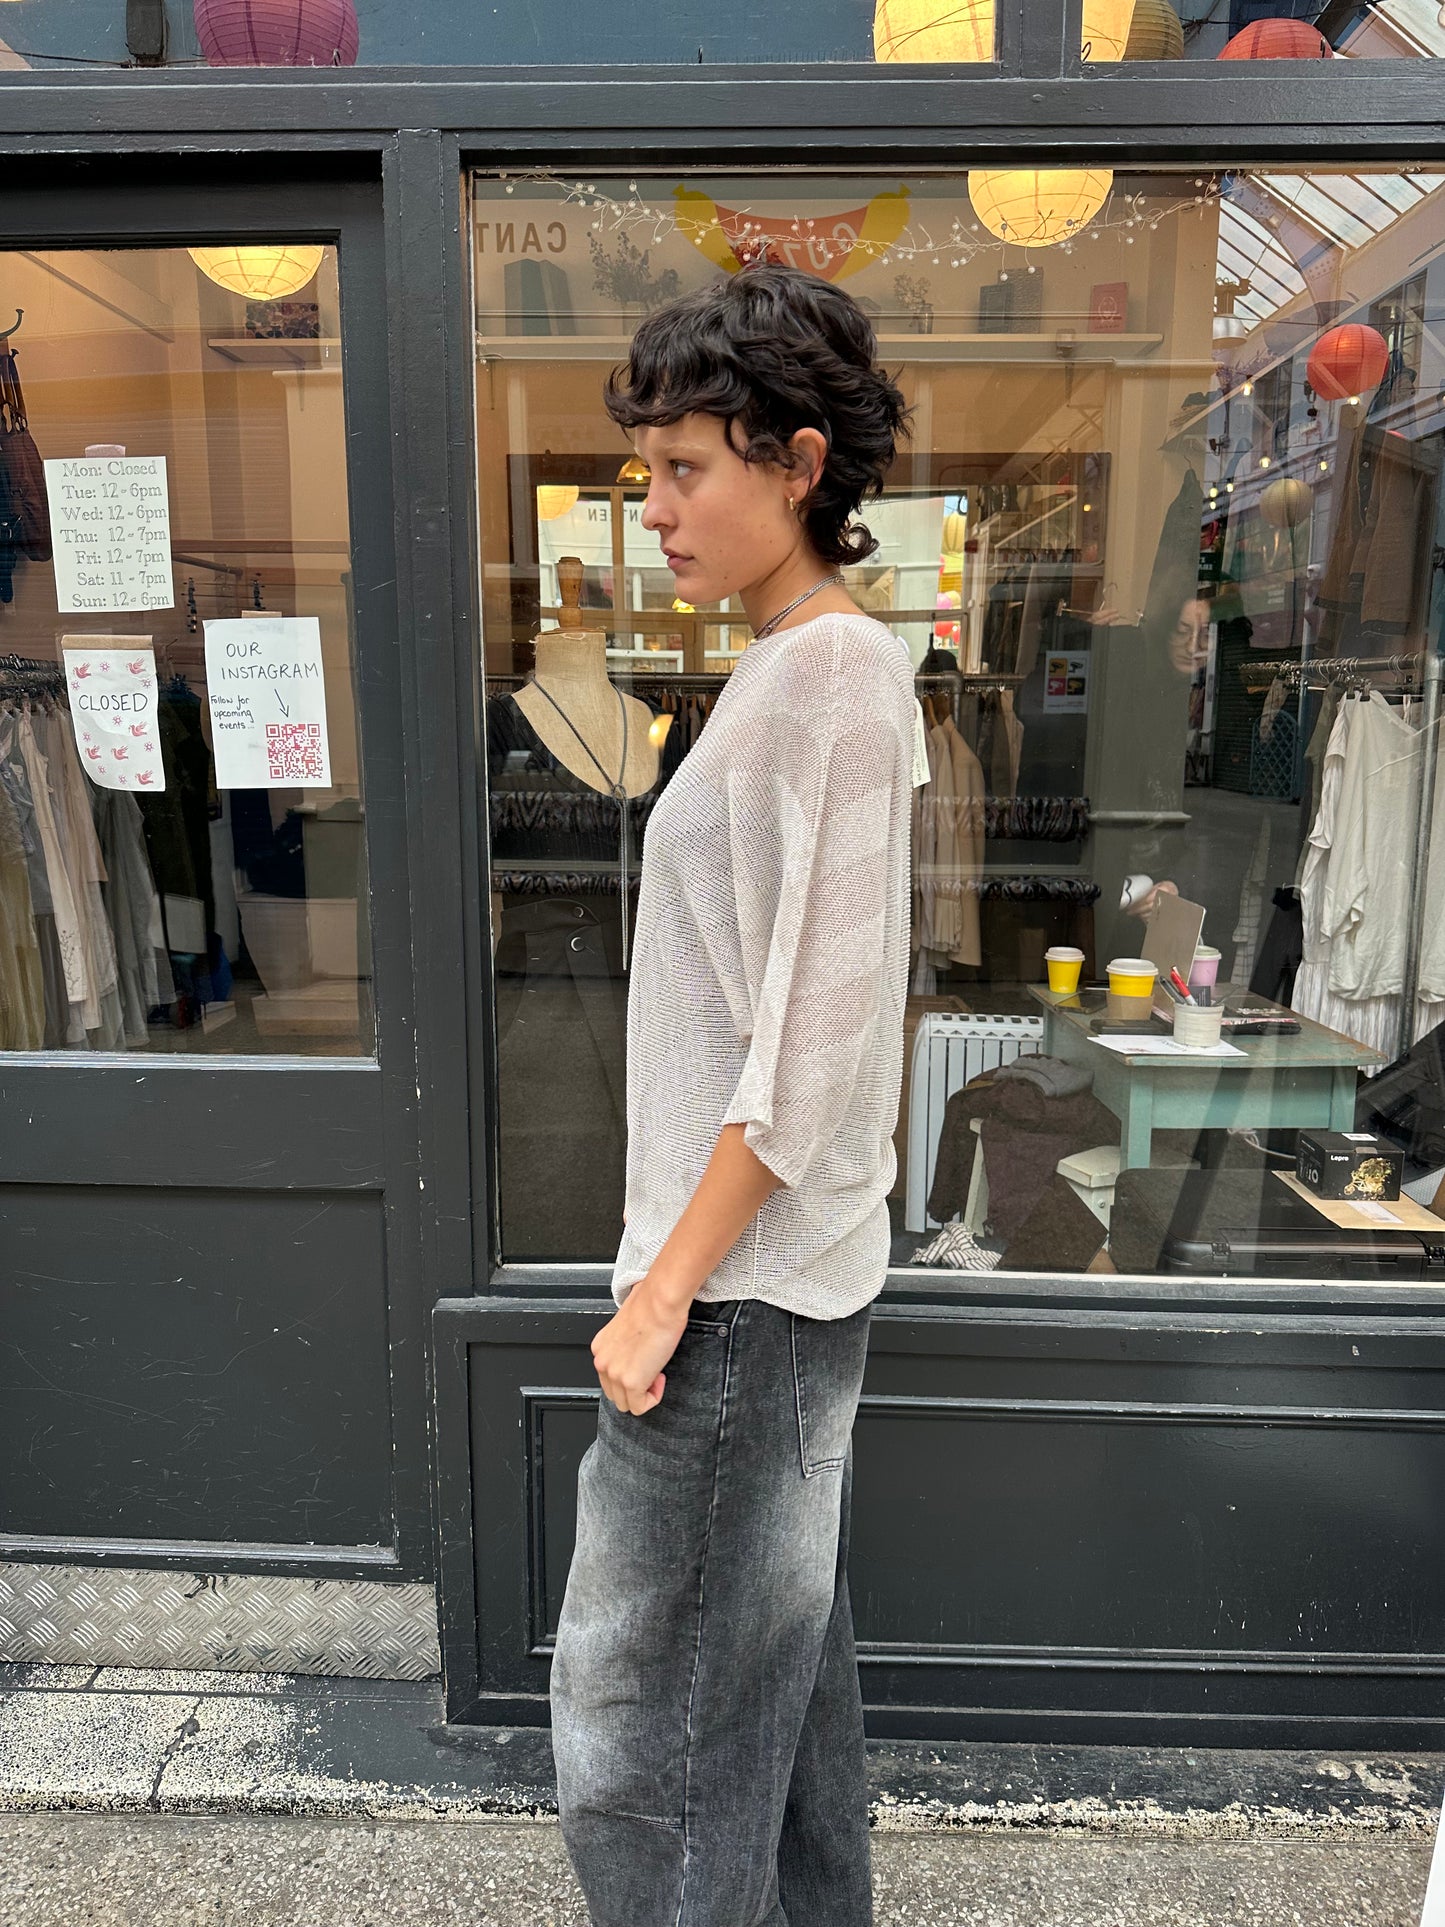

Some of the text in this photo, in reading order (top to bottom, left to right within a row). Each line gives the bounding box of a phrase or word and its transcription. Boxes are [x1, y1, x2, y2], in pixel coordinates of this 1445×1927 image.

[62, 460, 158, 477] Mon: Closed
[61, 485, 97, 499] Tue:
[61, 506, 103, 521] Wed:
[60, 529, 98, 543] Thu:
[74, 550, 102, 565] Fri:
[77, 572, 105, 586] Sat:
[72, 593, 107, 608] Sun:
[226, 641, 262, 658] OUR
[221, 662, 319, 680] INSTAGRAM
[78, 692, 148, 712] CLOSED
[210, 694, 250, 711] Follow for
[213, 707, 255, 724] upcoming
